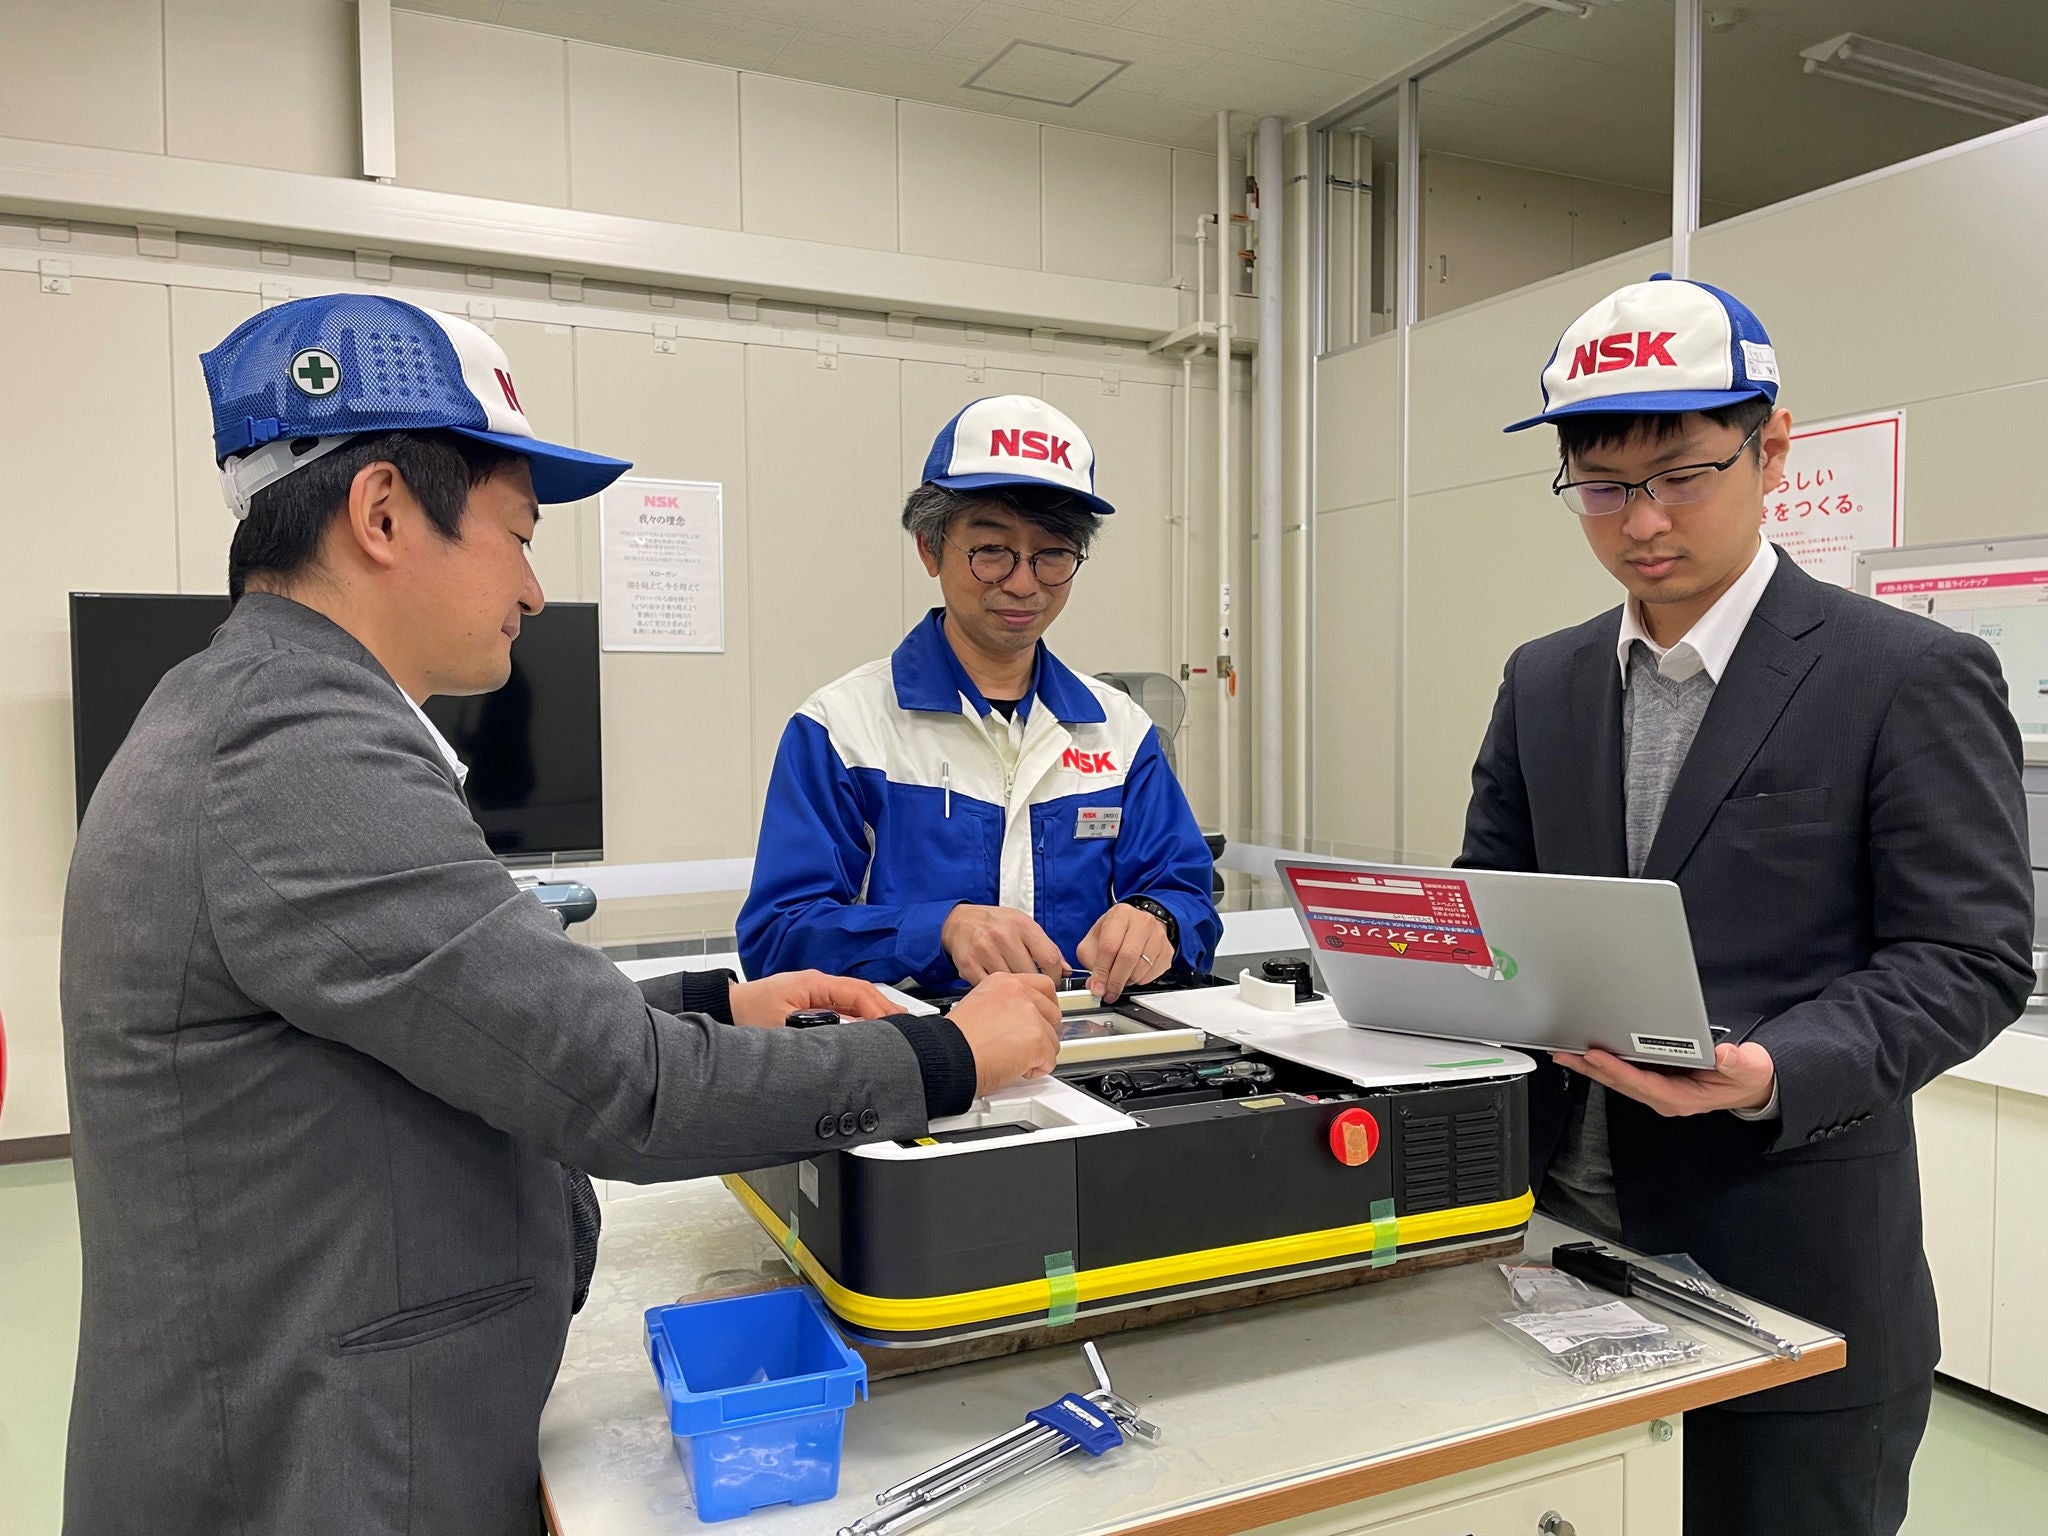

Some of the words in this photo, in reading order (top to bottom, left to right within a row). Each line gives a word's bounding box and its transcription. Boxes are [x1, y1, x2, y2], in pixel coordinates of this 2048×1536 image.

[1567, 331, 1677, 381] NSK
[990, 429, 1073, 471] NSK
[644, 496, 680, 508] NSK
[639, 514, 686, 527] 我々の理念
[1062, 747, 1117, 773] NSK
